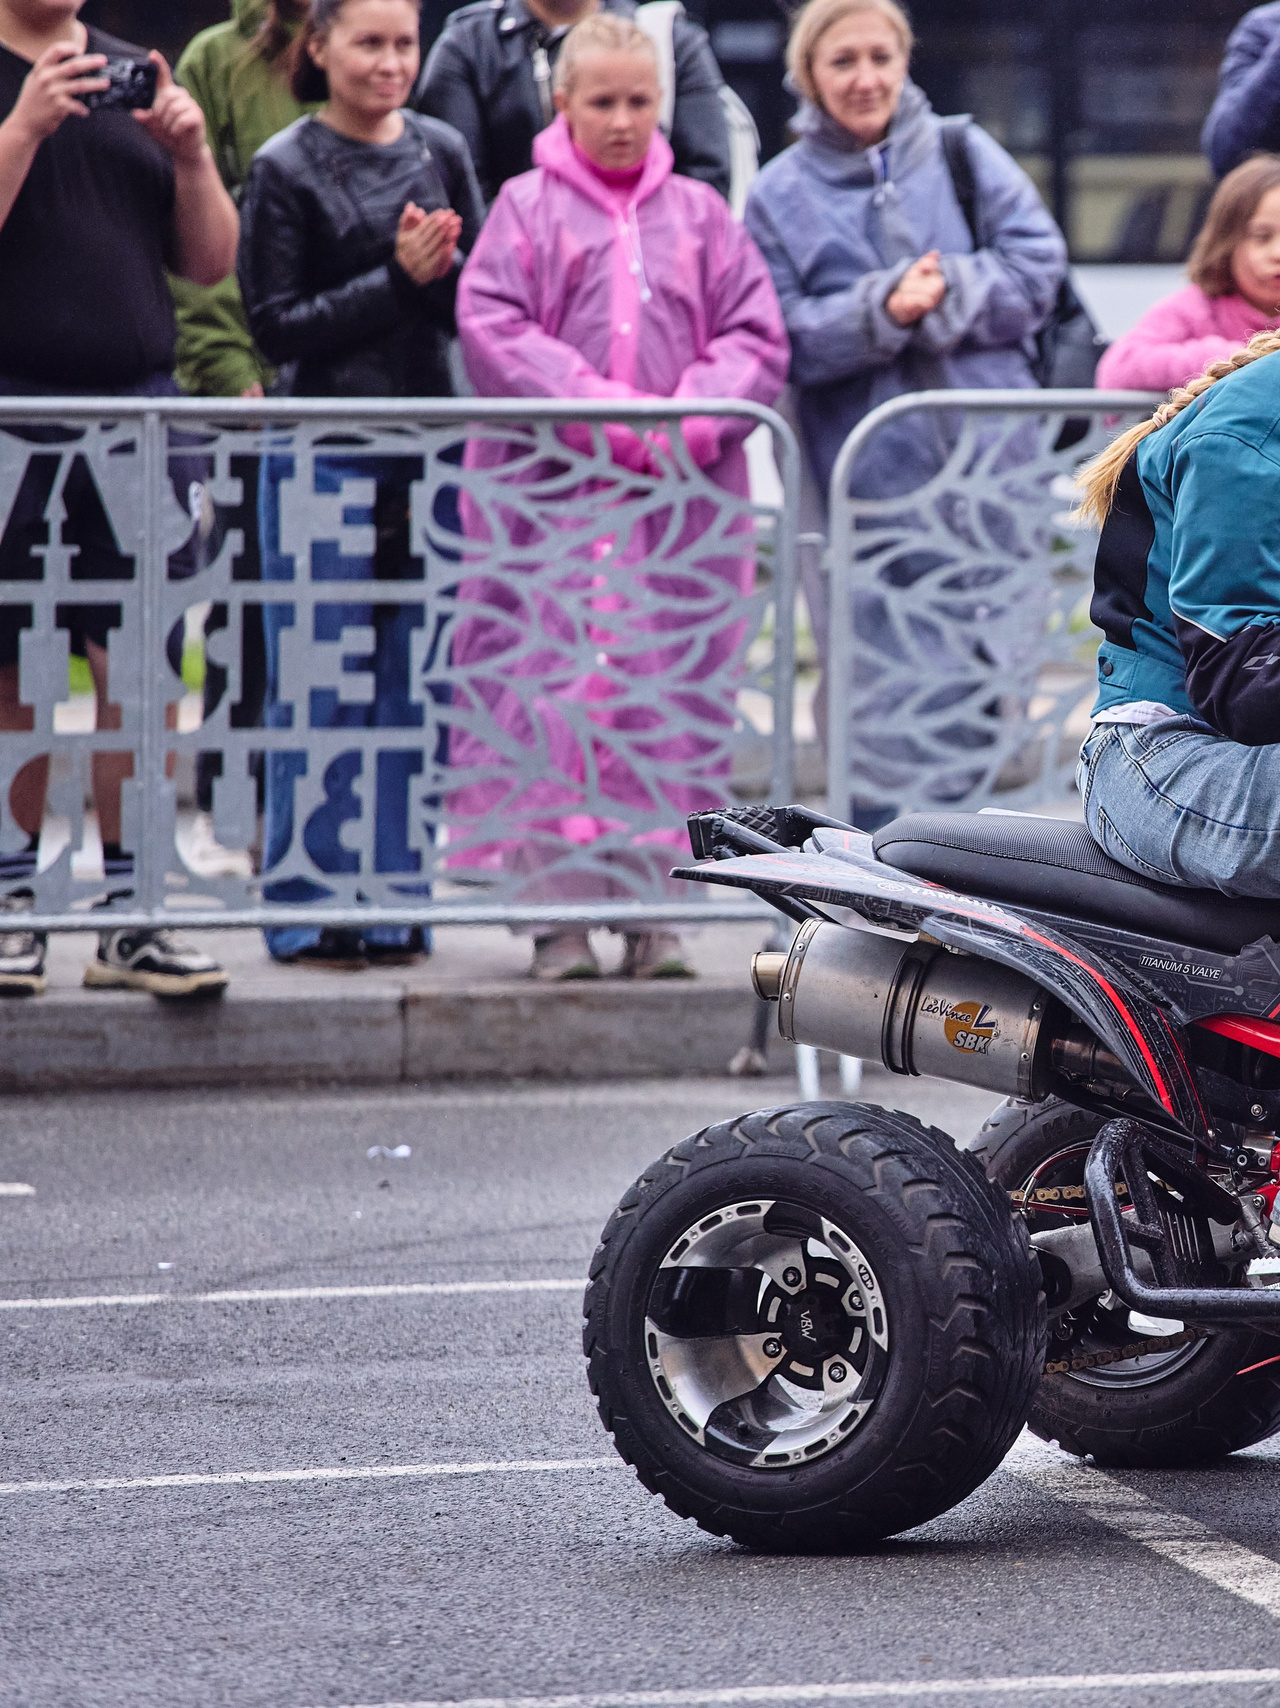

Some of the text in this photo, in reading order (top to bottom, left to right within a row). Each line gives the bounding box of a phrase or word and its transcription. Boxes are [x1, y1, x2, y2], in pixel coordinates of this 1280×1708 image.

[906, 883, 1005, 915] YAMAHA
[1140, 955, 1182, 973] TITANUM
[1182, 964, 1191, 974] 5
[953, 1029, 991, 1055] SBK
[859, 1265, 874, 1289] VBW
[800, 1309, 817, 1342] VBW
